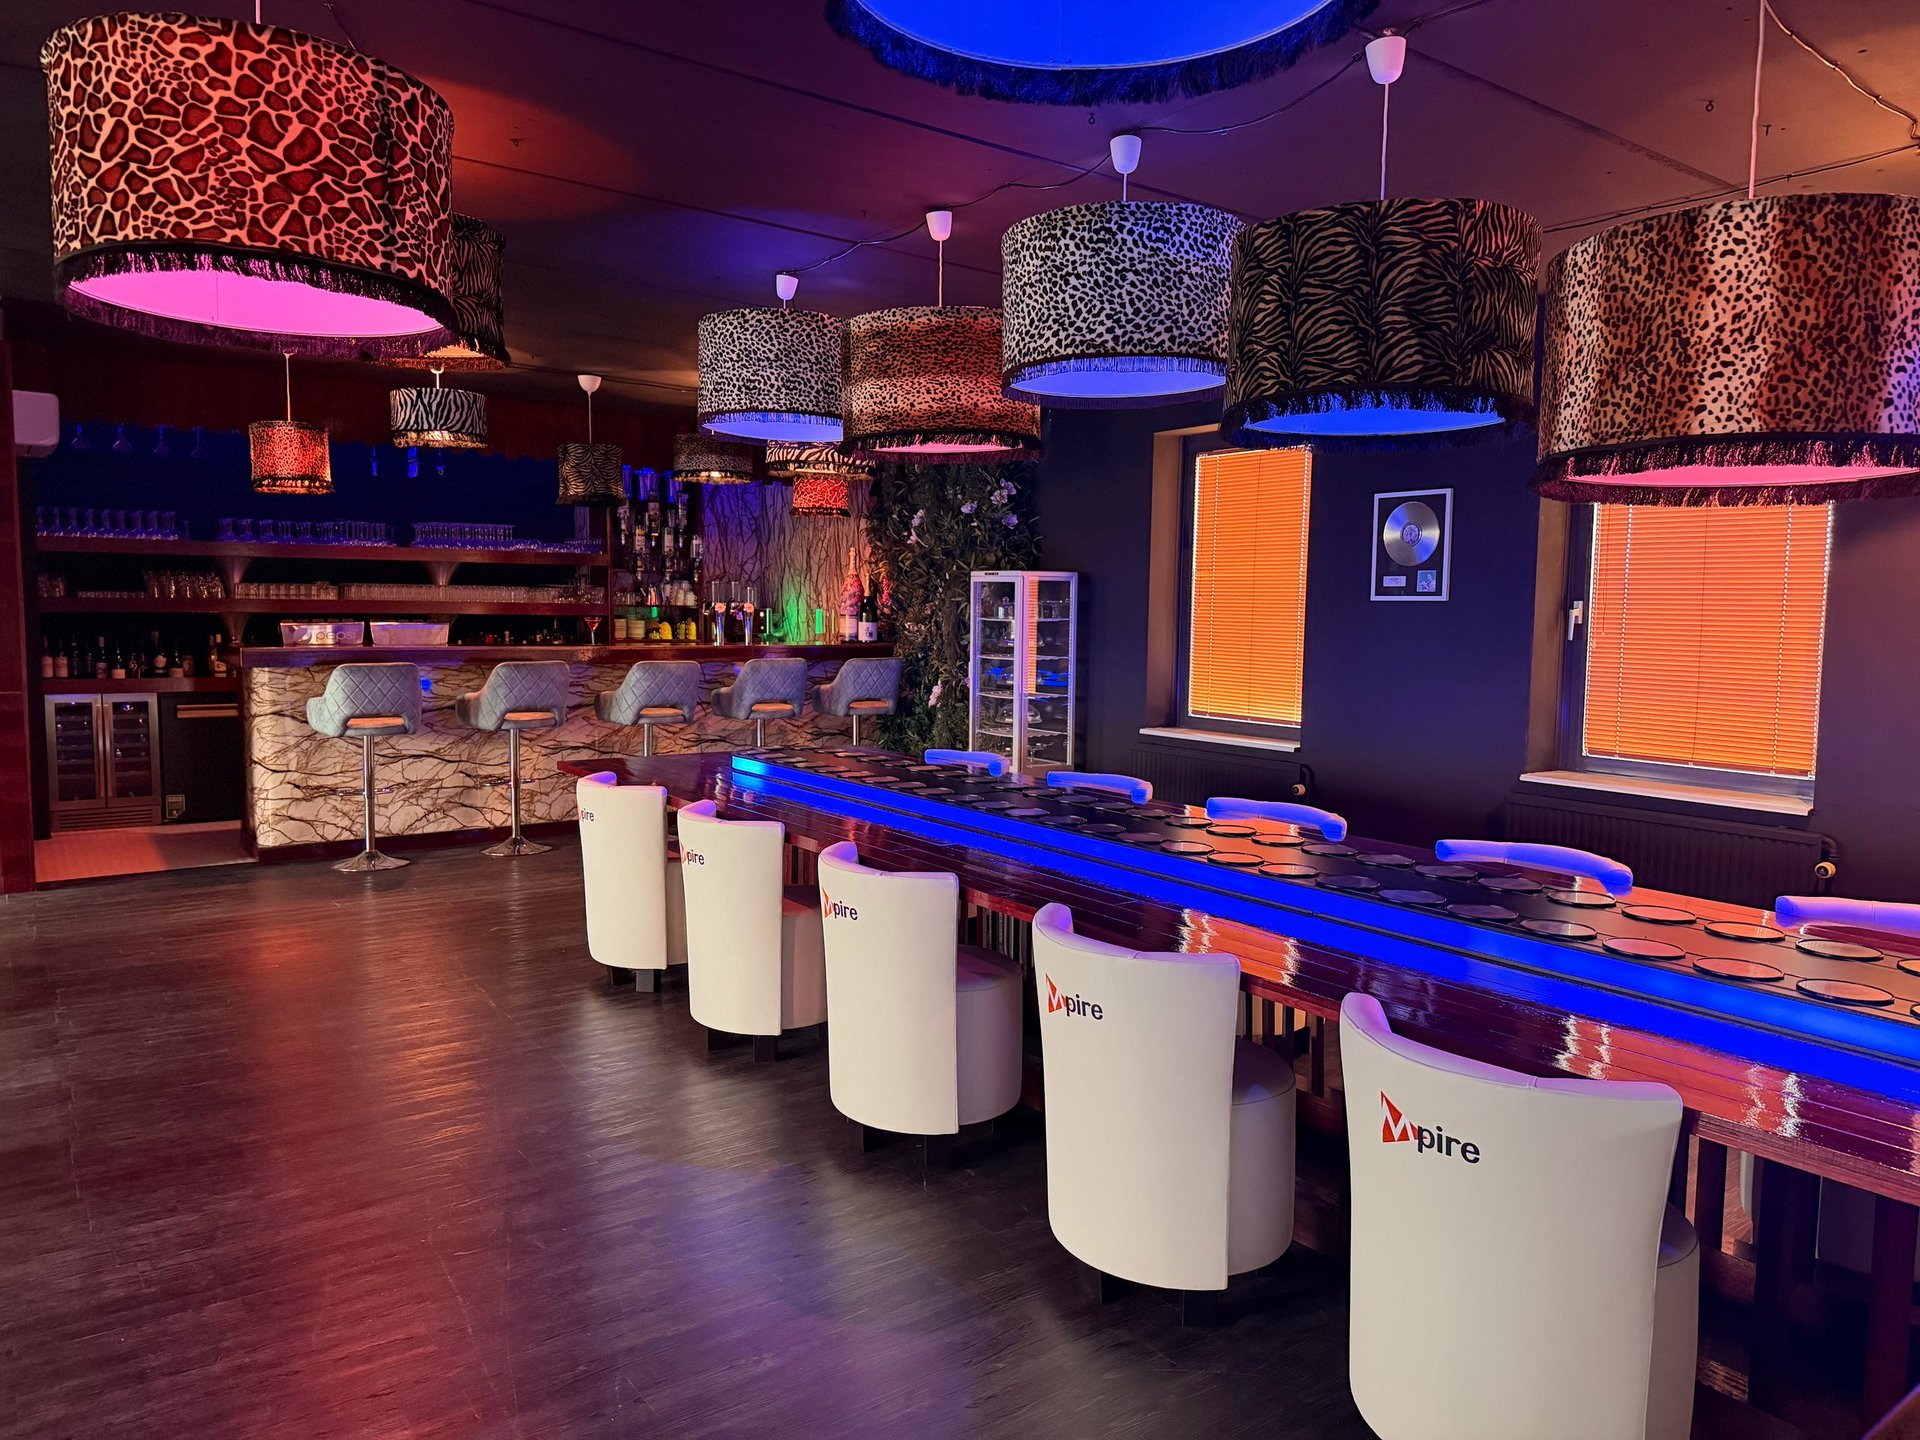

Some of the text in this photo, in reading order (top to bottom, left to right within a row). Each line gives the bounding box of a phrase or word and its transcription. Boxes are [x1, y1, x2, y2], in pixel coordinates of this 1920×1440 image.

[316, 630, 356, 642] pepsi
[822, 887, 858, 920] Mpire
[1045, 973, 1103, 1020] Mpire
[1380, 1091, 1480, 1164] Mpire
